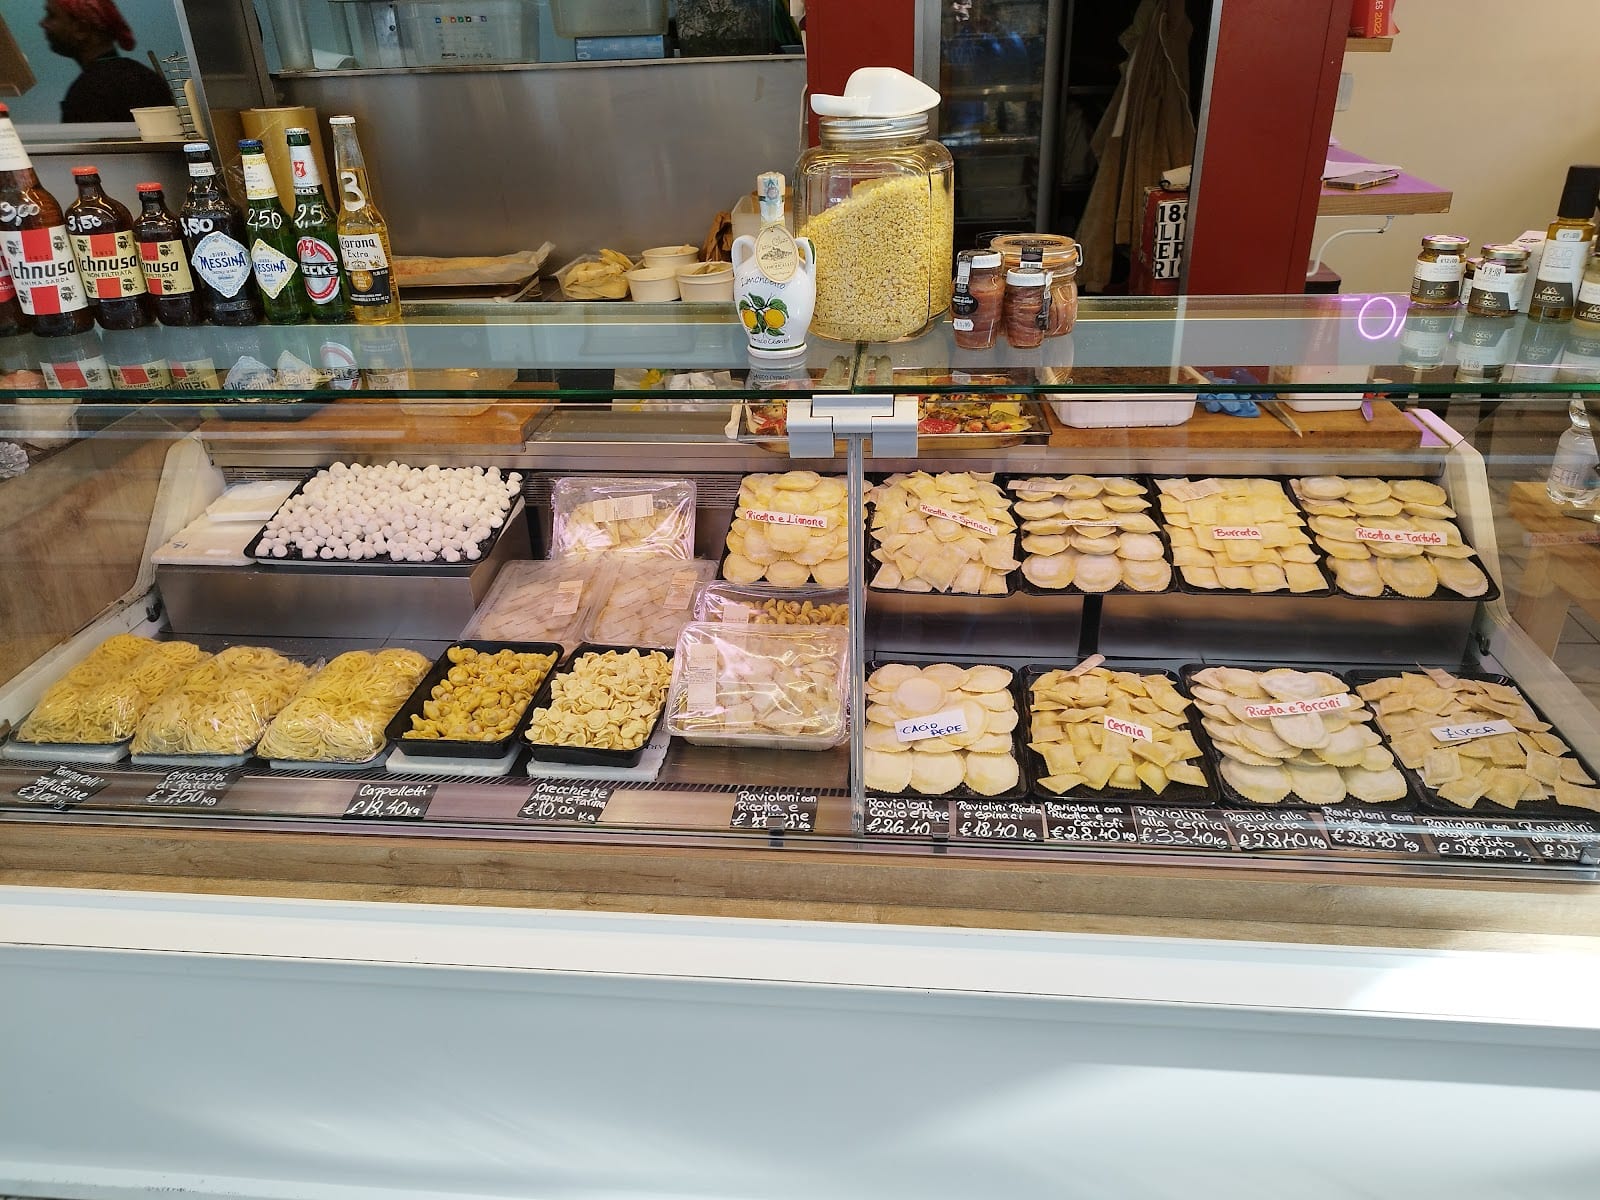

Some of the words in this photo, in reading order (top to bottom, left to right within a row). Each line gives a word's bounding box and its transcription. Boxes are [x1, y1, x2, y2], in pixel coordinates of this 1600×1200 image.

[341, 172, 365, 212] 3
[348, 250, 369, 258] Extra
[198, 252, 246, 271] MESSINA
[1154, 261, 1180, 278] RI
[1542, 294, 1565, 302] ROCCA
[1214, 528, 1260, 536] Burrata
[1356, 528, 1392, 540] Ricotta
[1404, 532, 1440, 544] Tartufo
[1246, 704, 1286, 716] Ricotta
[1296, 698, 1342, 712] Porcini
[1108, 719, 1146, 738] Cernia
[166, 771, 228, 782] Gnocchi
[156, 780, 172, 790] di
[176, 780, 226, 790] Patate
[536, 783, 608, 798] Orecchiette
[360, 784, 432, 800] Cappelletti
[738, 791, 800, 802] Ravioloni
[531, 792, 563, 804] Acqua
[572, 796, 606, 808] Farina
[866, 798, 933, 810] Ravioloni
[735, 801, 782, 812] Ricotta
[788, 804, 799, 812] e
[957, 801, 1007, 811] Raviolini
[1009, 804, 1042, 814] Ricotta
[1045, 802, 1100, 814] Ravioloni
[1104, 806, 1124, 814] con
[870, 808, 908, 818] Cacio
[910, 810, 918, 818] e
[918, 808, 950, 822] Pepe
[1047, 810, 1090, 820] Ricotta
[1136, 806, 1208, 820] Raviolini
[1224, 812, 1276, 822] Ravioli
[1279, 812, 1306, 820] alla
[1321, 806, 1387, 820] Ravioloni
[1391, 814, 1415, 822] con
[1074, 818, 1124, 828] Carciofi
[1141, 817, 1168, 828] alla
[1174, 819, 1228, 832] Cernia
[1236, 821, 1305, 832] Burrata
[1423, 818, 1487, 830] Ravioloni
[1454, 837, 1515, 848] Tartufo
[1532, 834, 1555, 842] alla
